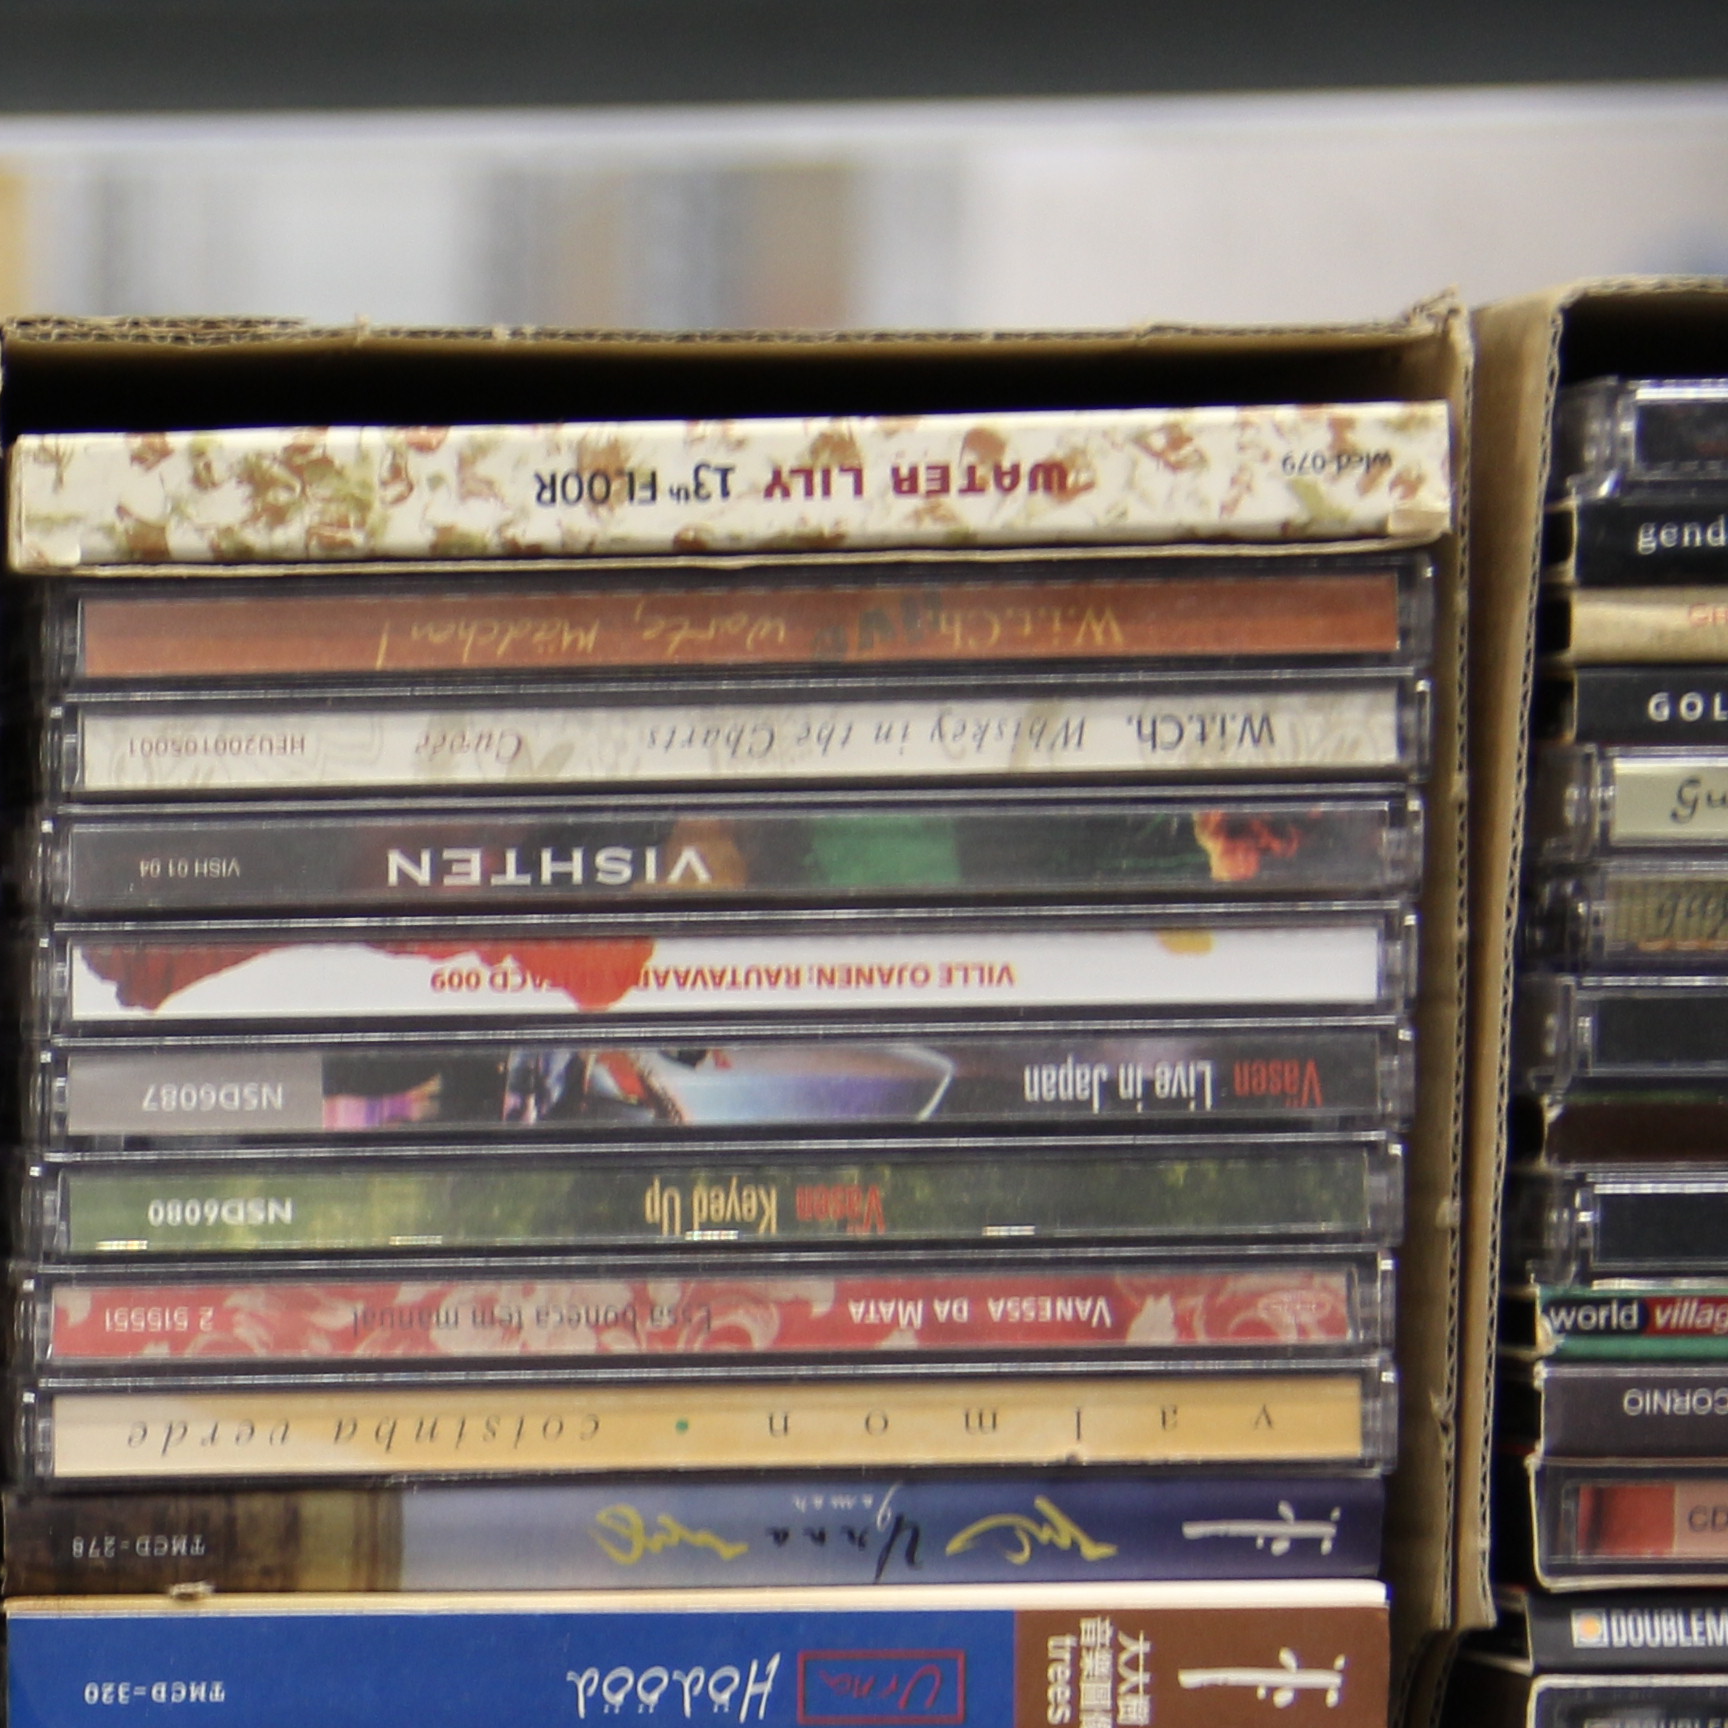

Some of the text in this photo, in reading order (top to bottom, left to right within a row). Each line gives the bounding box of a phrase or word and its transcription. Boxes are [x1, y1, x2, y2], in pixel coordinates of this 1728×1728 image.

[534, 468, 658, 506] FLOOR
[763, 466, 864, 500] LILY
[890, 461, 1069, 498] WATER
[386, 846, 711, 887] VISHTEN
[140, 1081, 283, 1111] NSD6087
[1024, 1056, 1322, 1111] Väsen Live in Japan
[849, 1296, 1111, 1328] VANESSA DA MATA
[1549, 1299, 1640, 1332] world
